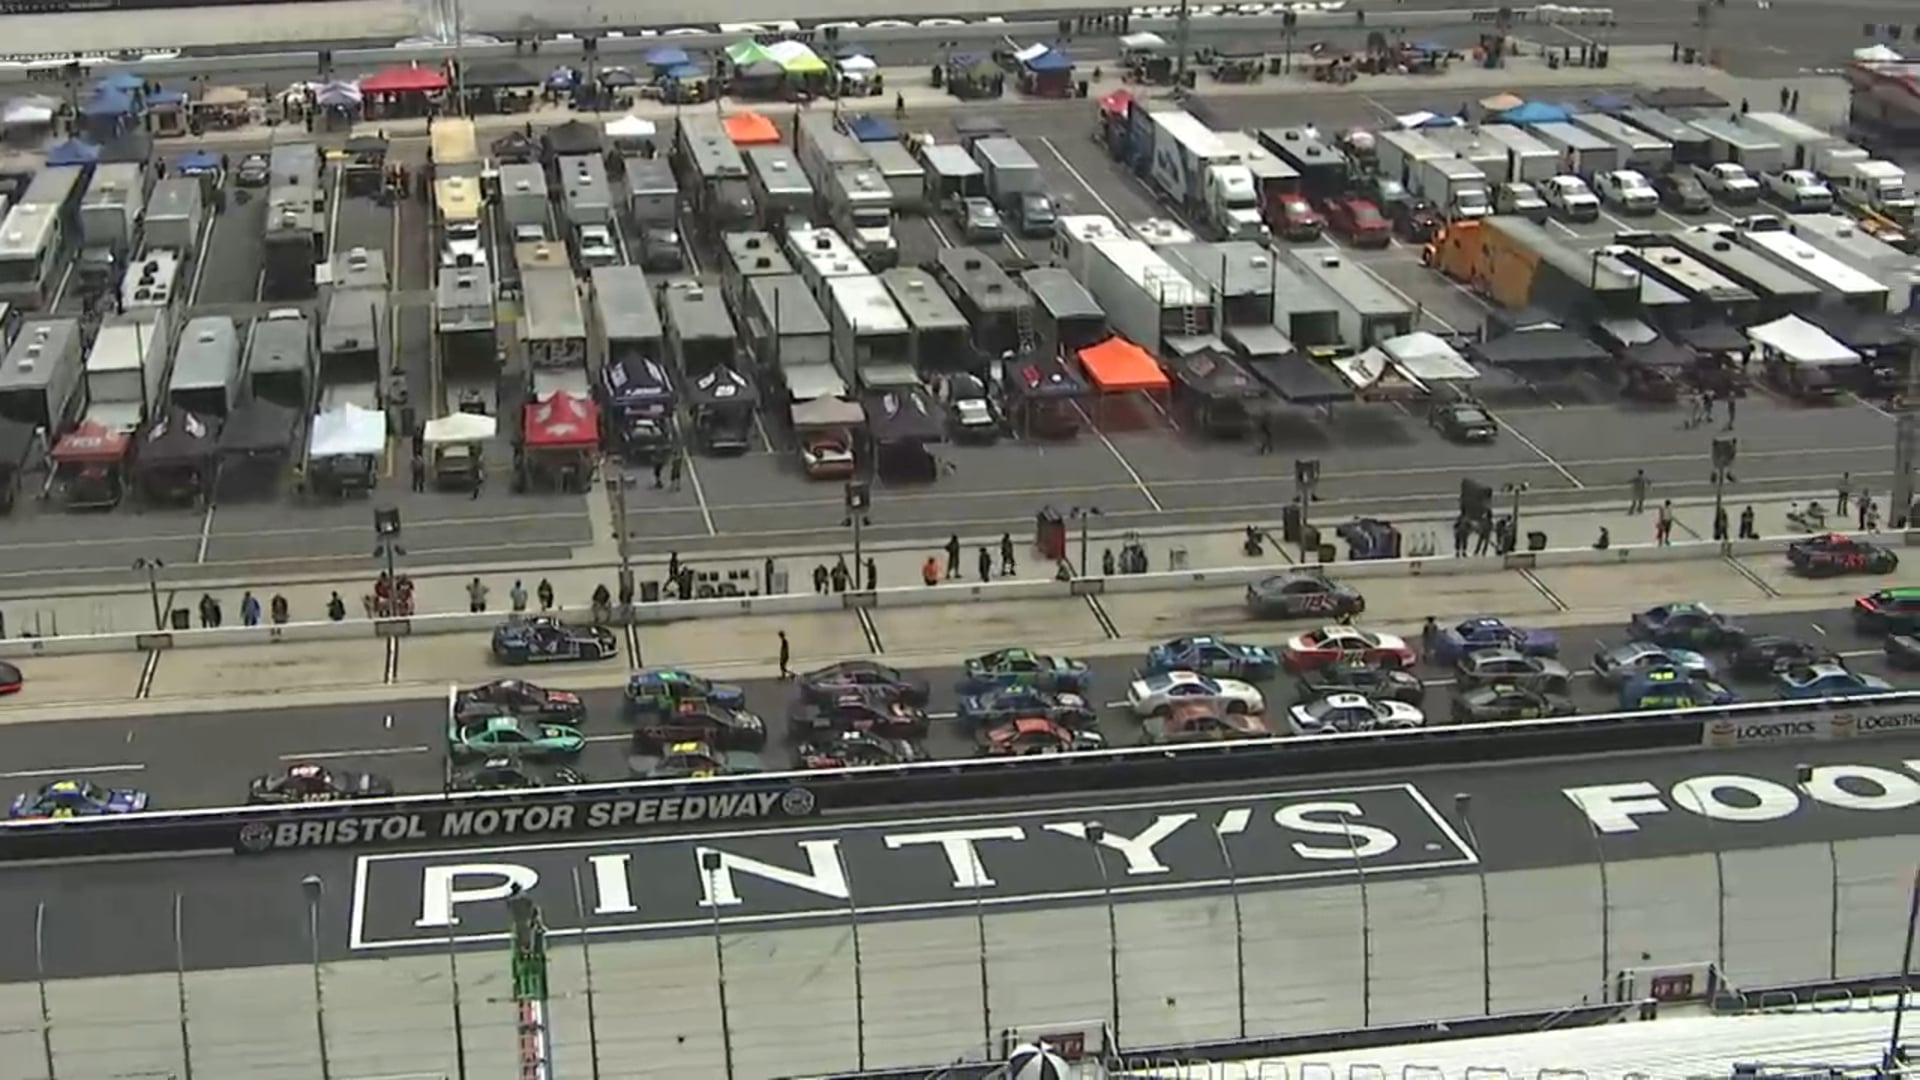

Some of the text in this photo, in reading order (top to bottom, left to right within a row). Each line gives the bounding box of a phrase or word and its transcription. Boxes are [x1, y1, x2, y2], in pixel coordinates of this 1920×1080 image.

[1736, 721, 1816, 739] LOGISTICS
[273, 815, 426, 847] BRISTOL
[441, 803, 575, 837] MOTOR
[587, 790, 780, 828] SPEEDWAY
[1561, 759, 1920, 833] FOO
[414, 801, 1398, 929] PINTY'S
